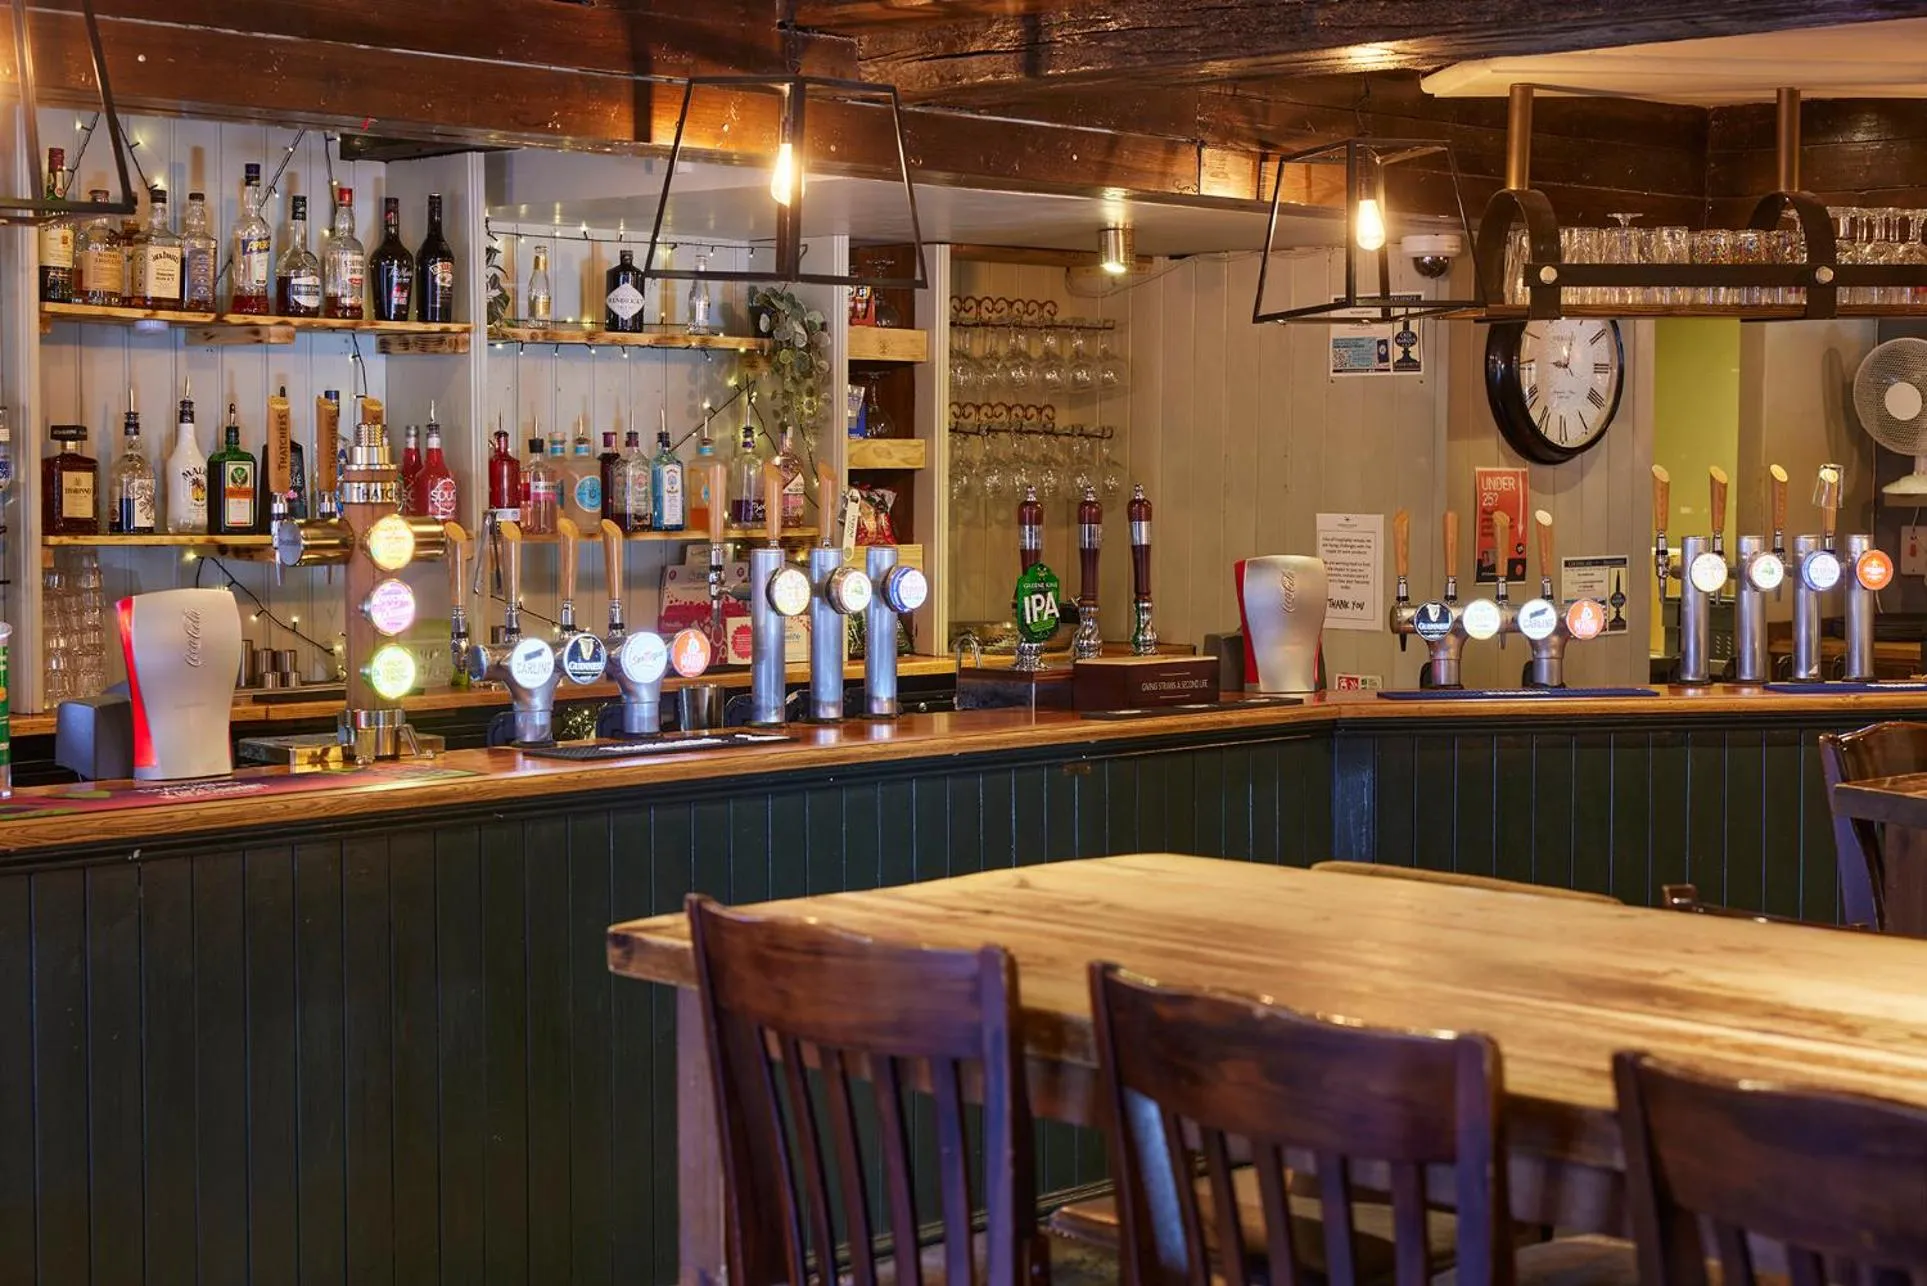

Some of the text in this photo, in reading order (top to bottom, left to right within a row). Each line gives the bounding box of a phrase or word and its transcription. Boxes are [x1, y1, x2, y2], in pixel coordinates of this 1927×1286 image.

[277, 413, 288, 472] THATCHERS
[1481, 476, 1516, 492] UNDER
[1482, 492, 1499, 506] 25?
[1023, 591, 1060, 625] IPA
[1327, 598, 1365, 611] THANK YOU
[1417, 622, 1450, 631] GUINNESS
[568, 661, 604, 671] GUINNESS
